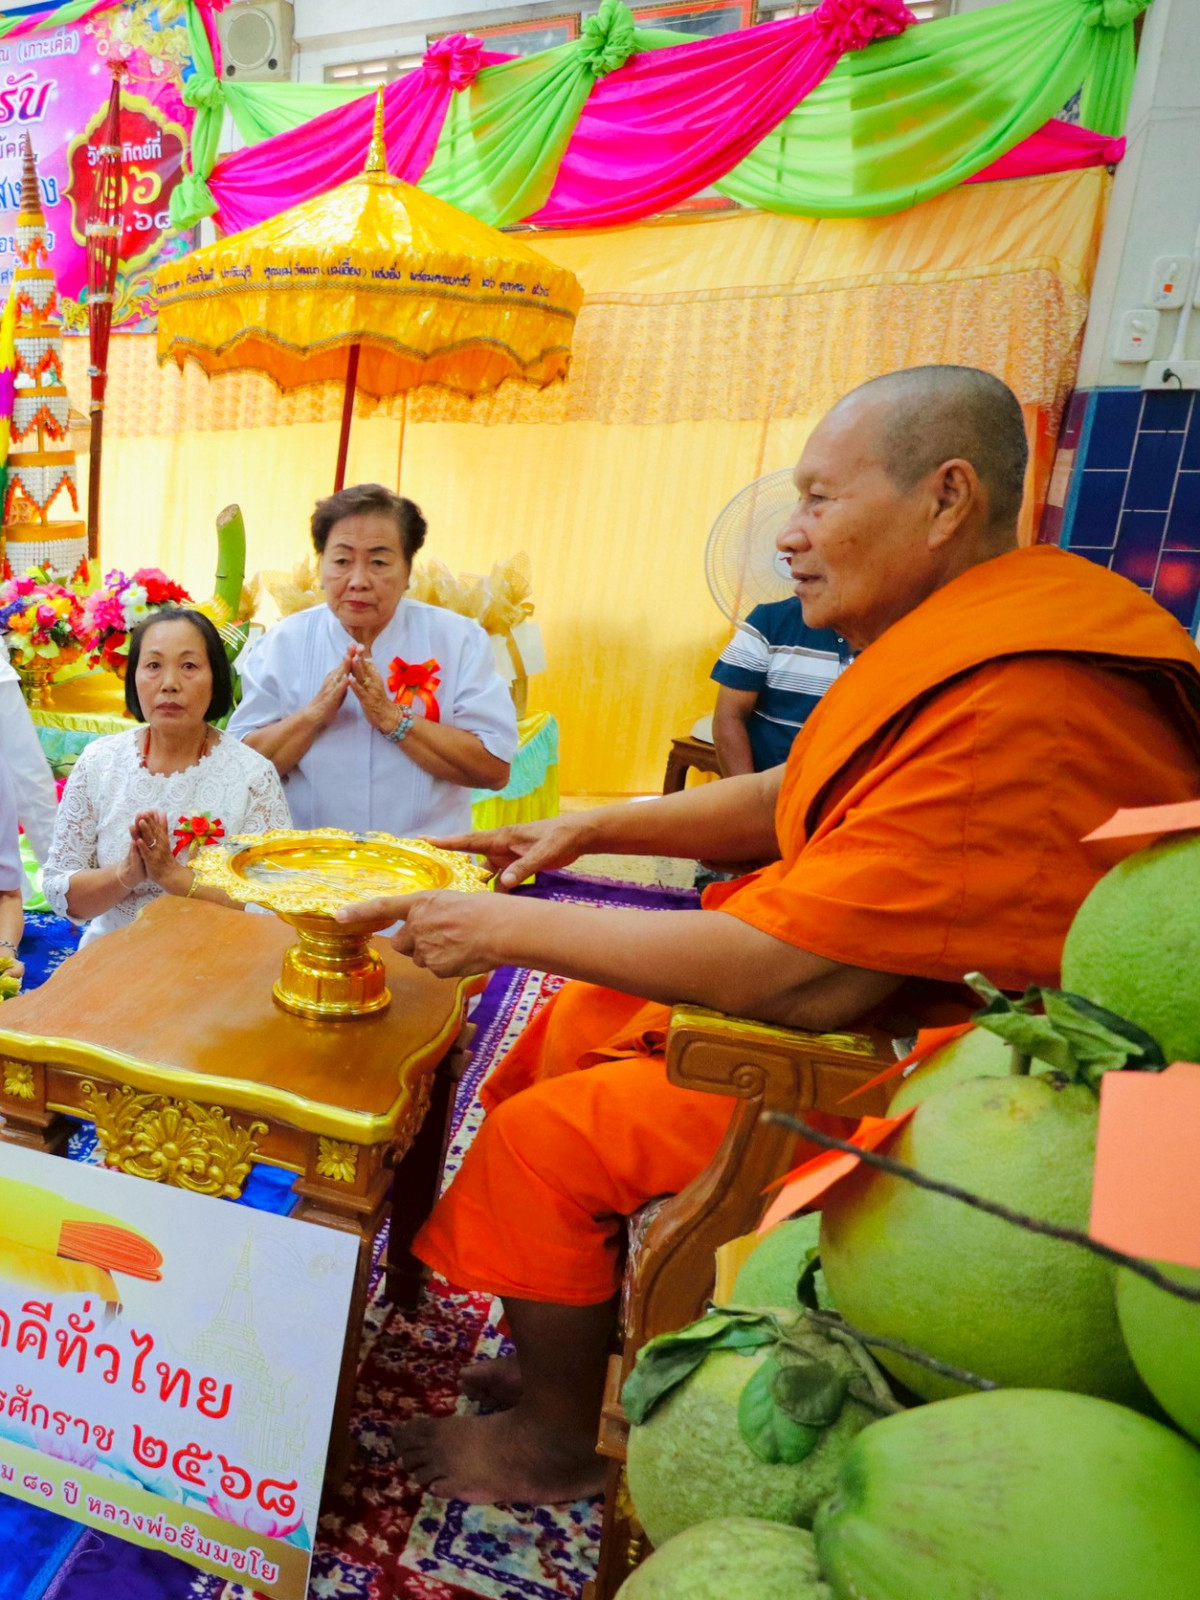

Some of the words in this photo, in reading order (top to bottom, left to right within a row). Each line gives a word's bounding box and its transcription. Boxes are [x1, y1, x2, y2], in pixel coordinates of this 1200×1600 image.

[132, 1423, 299, 1518] ๒๕๖๘
[23, 1473, 54, 1498] ๘๑
[63, 1480, 79, 1506] ปี
[87, 1494, 278, 1582] หลวงพ่อธัมมชโย
